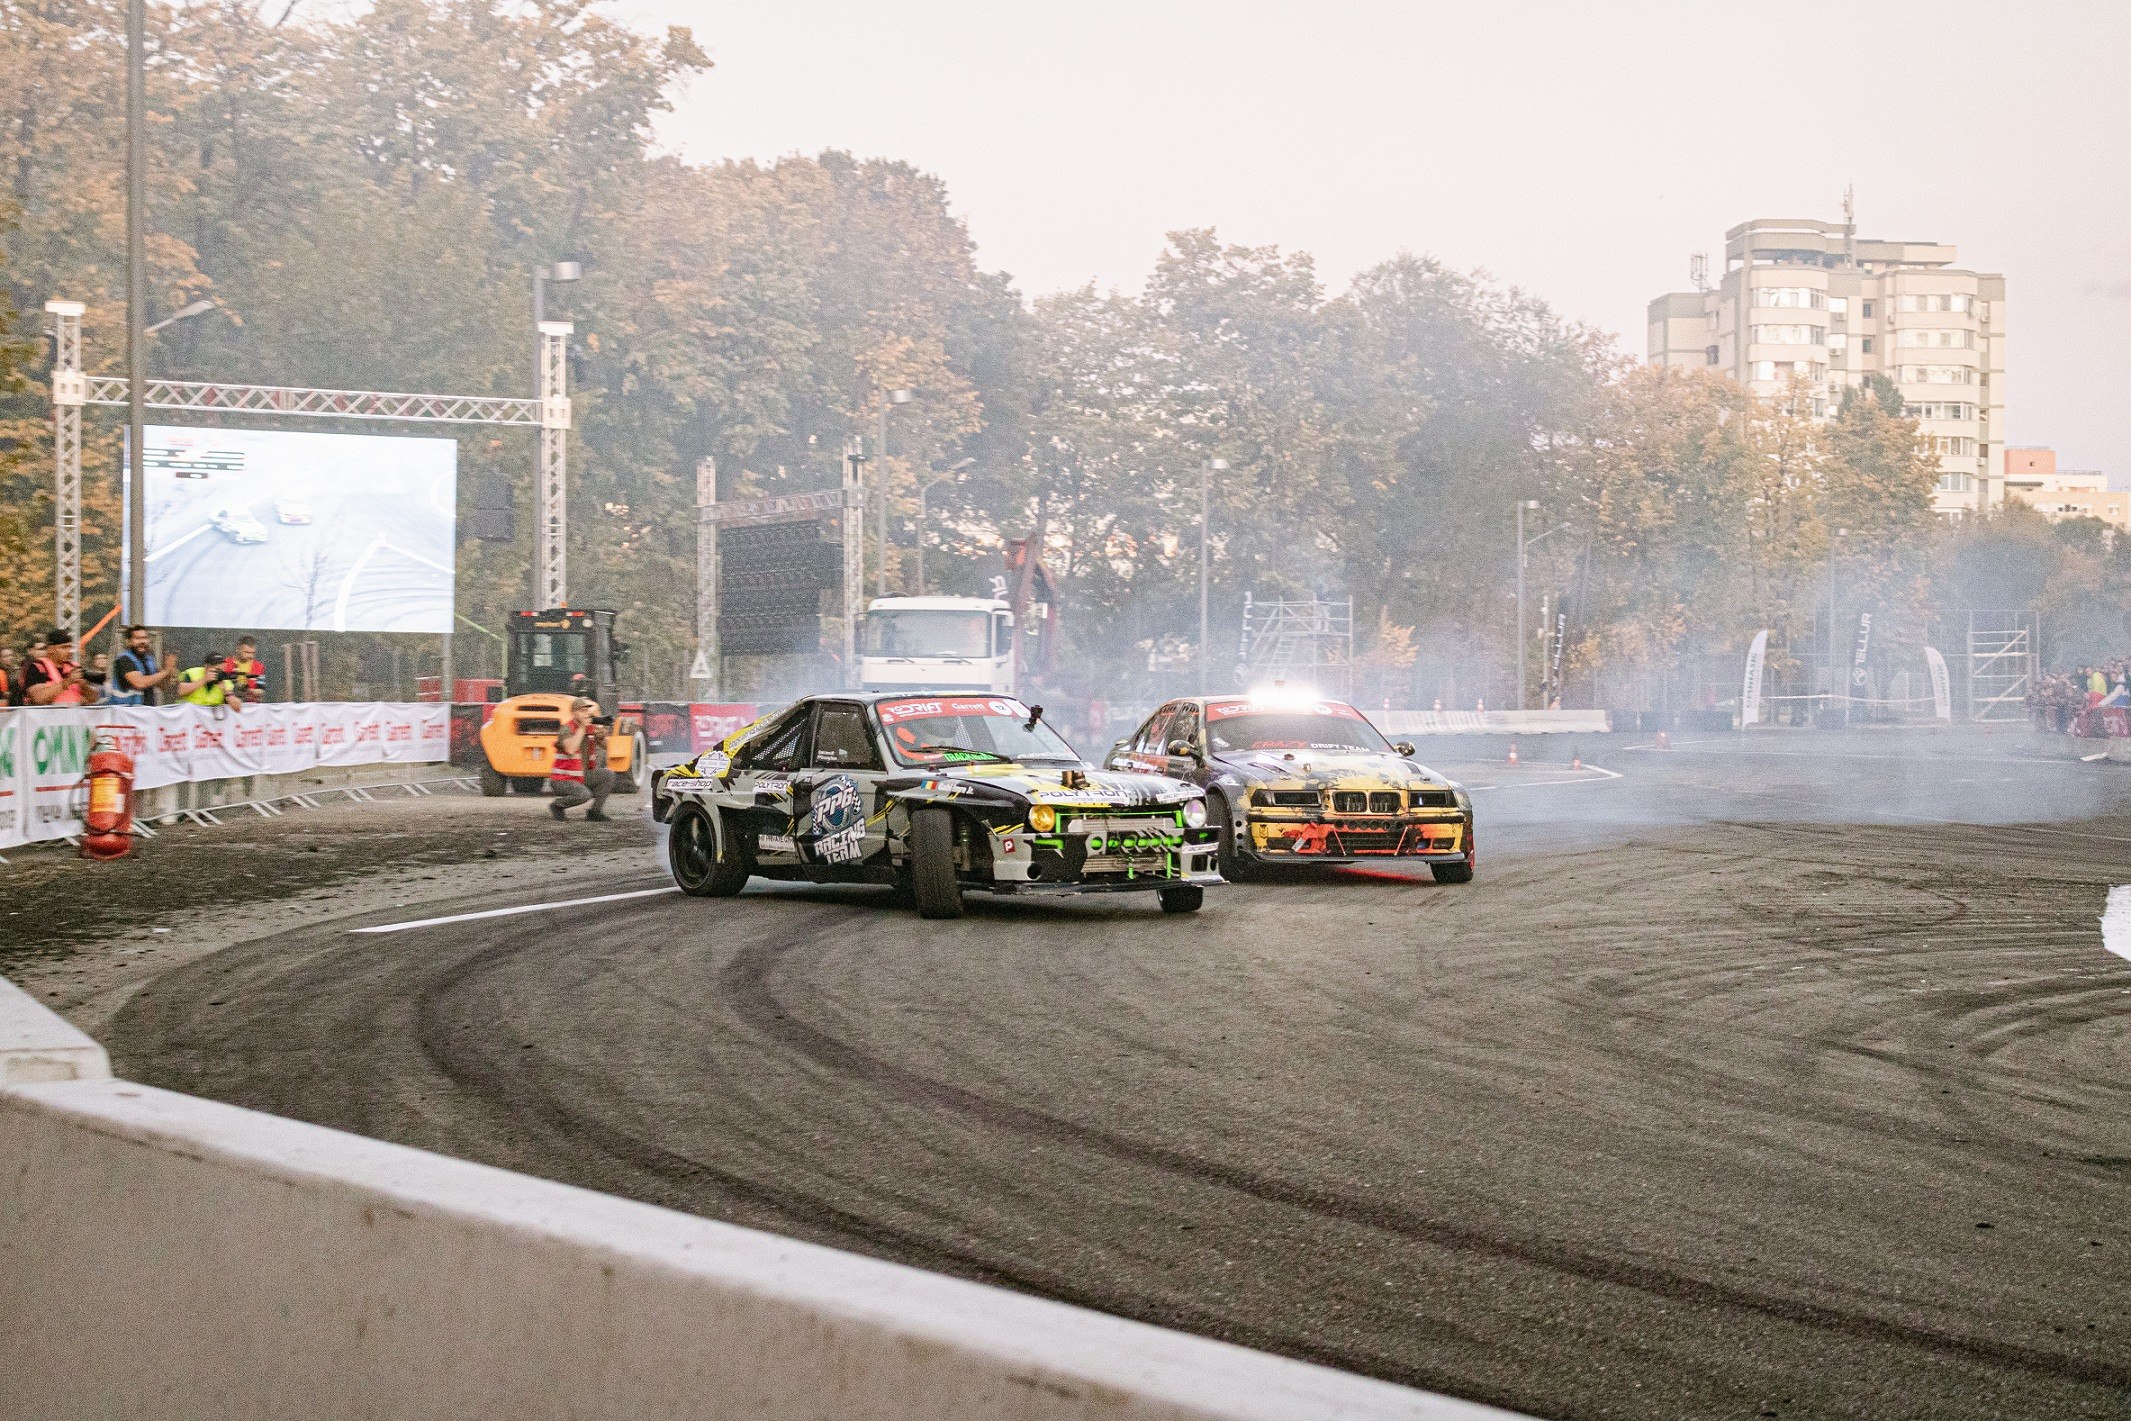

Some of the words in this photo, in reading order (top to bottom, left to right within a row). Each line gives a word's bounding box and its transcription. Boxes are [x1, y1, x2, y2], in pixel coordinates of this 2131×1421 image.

[1855, 613, 1872, 665] TELLUR
[951, 703, 985, 711] Garrett
[1343, 744, 1370, 752] TEAM
[668, 779, 712, 789] race-shop
[755, 781, 790, 790] POLYTRON
[1040, 790, 1129, 798] POLYTRON
[817, 787, 855, 823] PPG
[814, 817, 866, 857] RACING
[1004, 840, 1013, 852] P
[823, 840, 862, 865] TEAM
